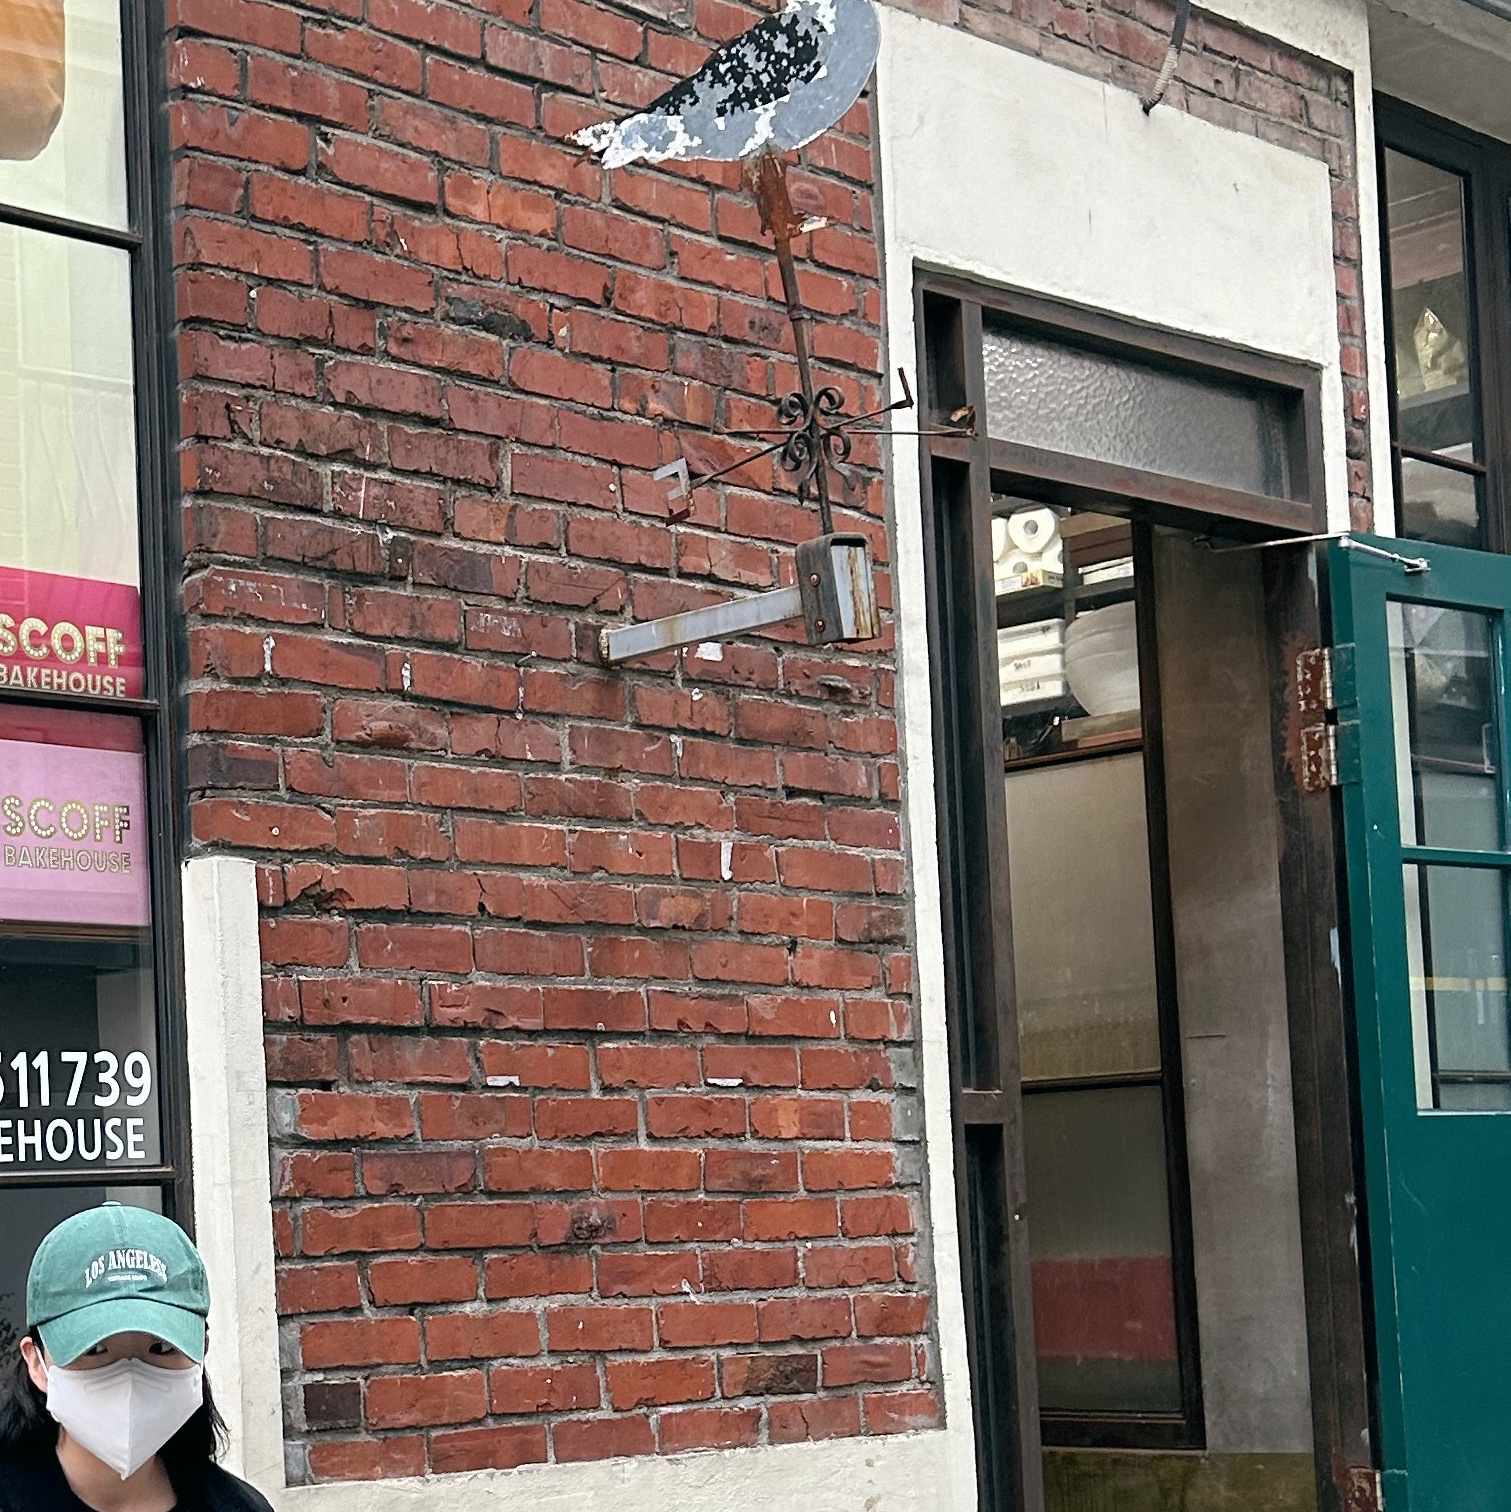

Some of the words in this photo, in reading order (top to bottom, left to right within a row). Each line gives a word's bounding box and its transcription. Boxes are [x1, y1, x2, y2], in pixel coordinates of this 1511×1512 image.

[1, 795, 130, 844] SCOFF
[3, 844, 131, 874] BAKEHOUSE
[84, 1255, 105, 1288] LOS
